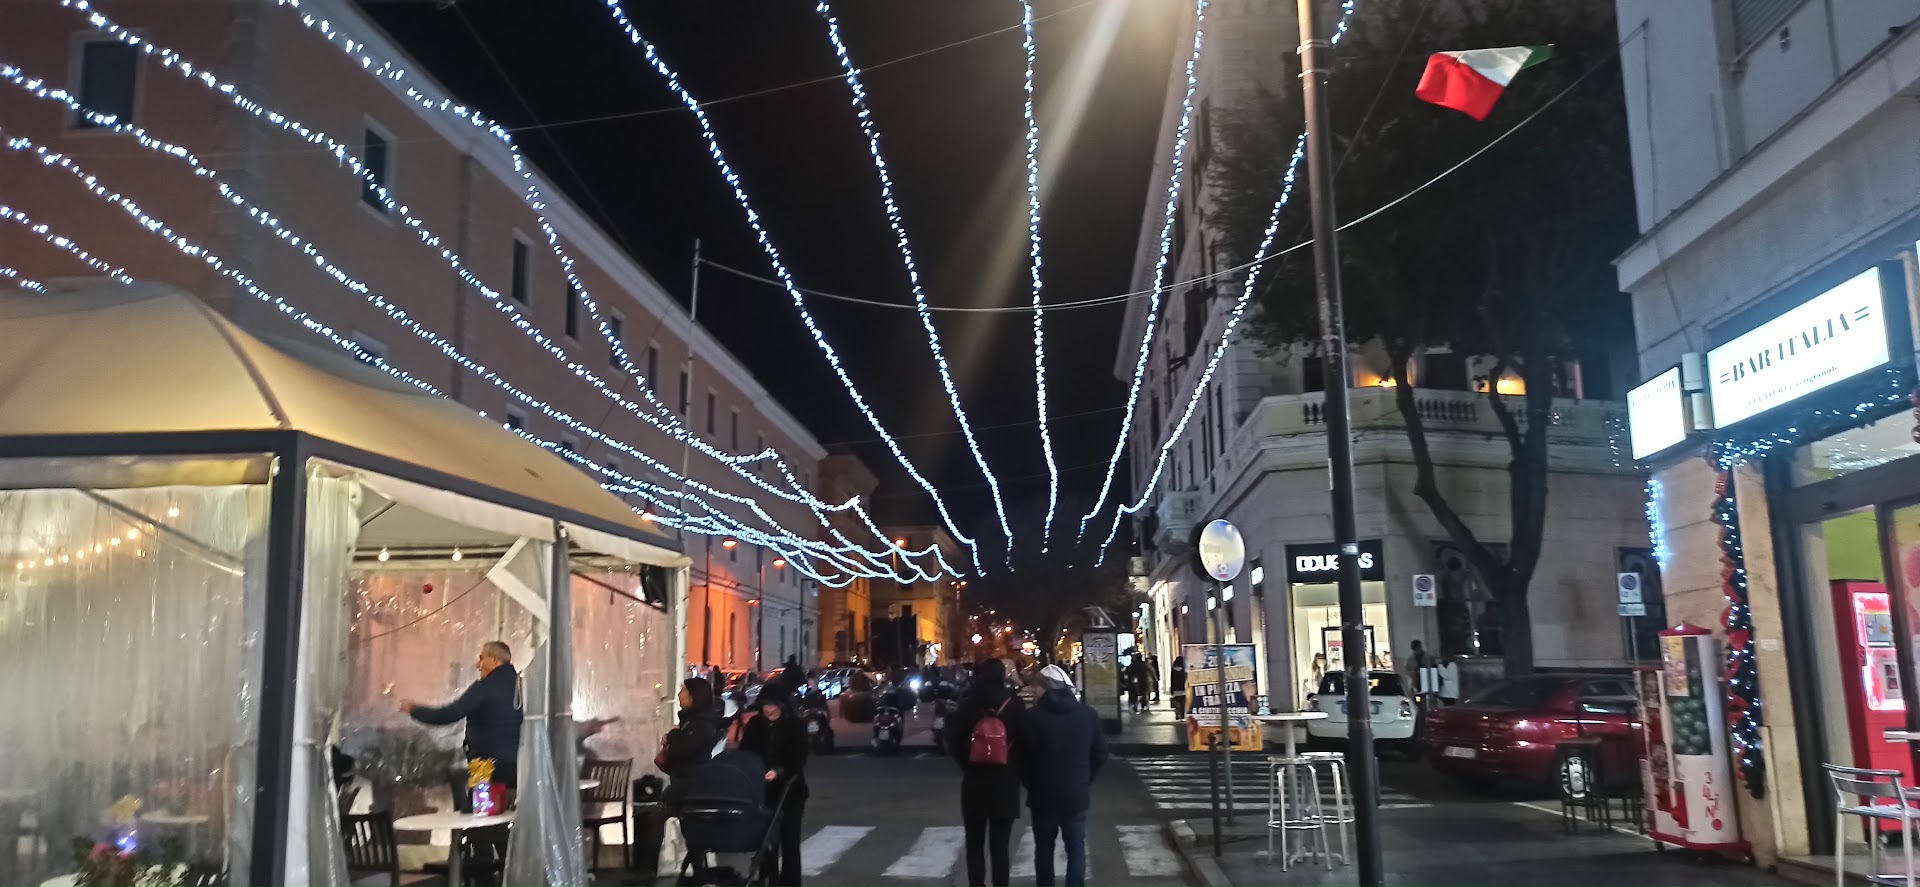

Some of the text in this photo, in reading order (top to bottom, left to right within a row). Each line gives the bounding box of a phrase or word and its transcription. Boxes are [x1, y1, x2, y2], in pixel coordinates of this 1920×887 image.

[1733, 313, 1850, 381] BAR ITALIA
[1295, 552, 1374, 572] DOUGS
[1207, 655, 1232, 667] 204
[1194, 682, 1241, 697] IN PIZZA
[1202, 693, 1236, 707] FRATI
[1198, 706, 1248, 714] CIVITACCHIA
